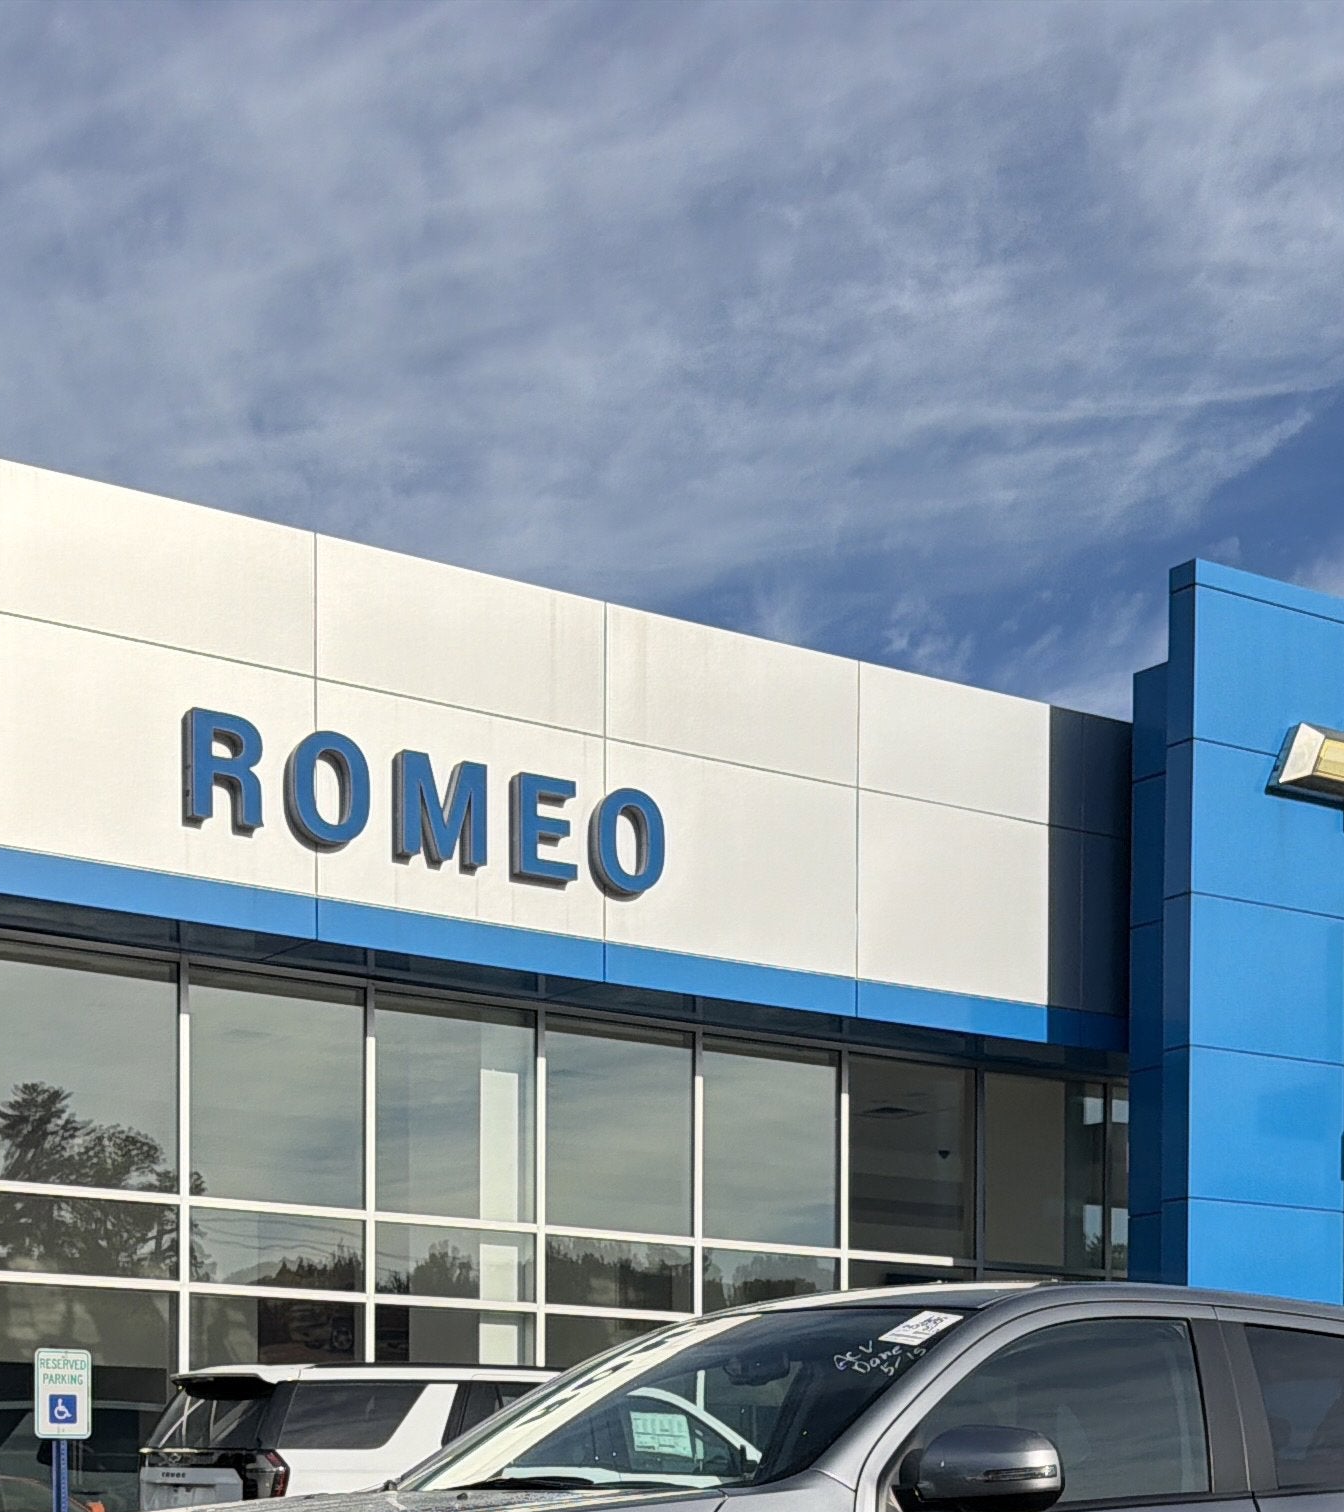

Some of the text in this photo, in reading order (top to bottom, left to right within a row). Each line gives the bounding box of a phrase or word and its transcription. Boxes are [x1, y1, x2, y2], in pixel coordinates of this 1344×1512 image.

[181, 706, 666, 902] ROMEO
[39, 1358, 87, 1371] RESERVED
[42, 1372, 84, 1386] PARKING
